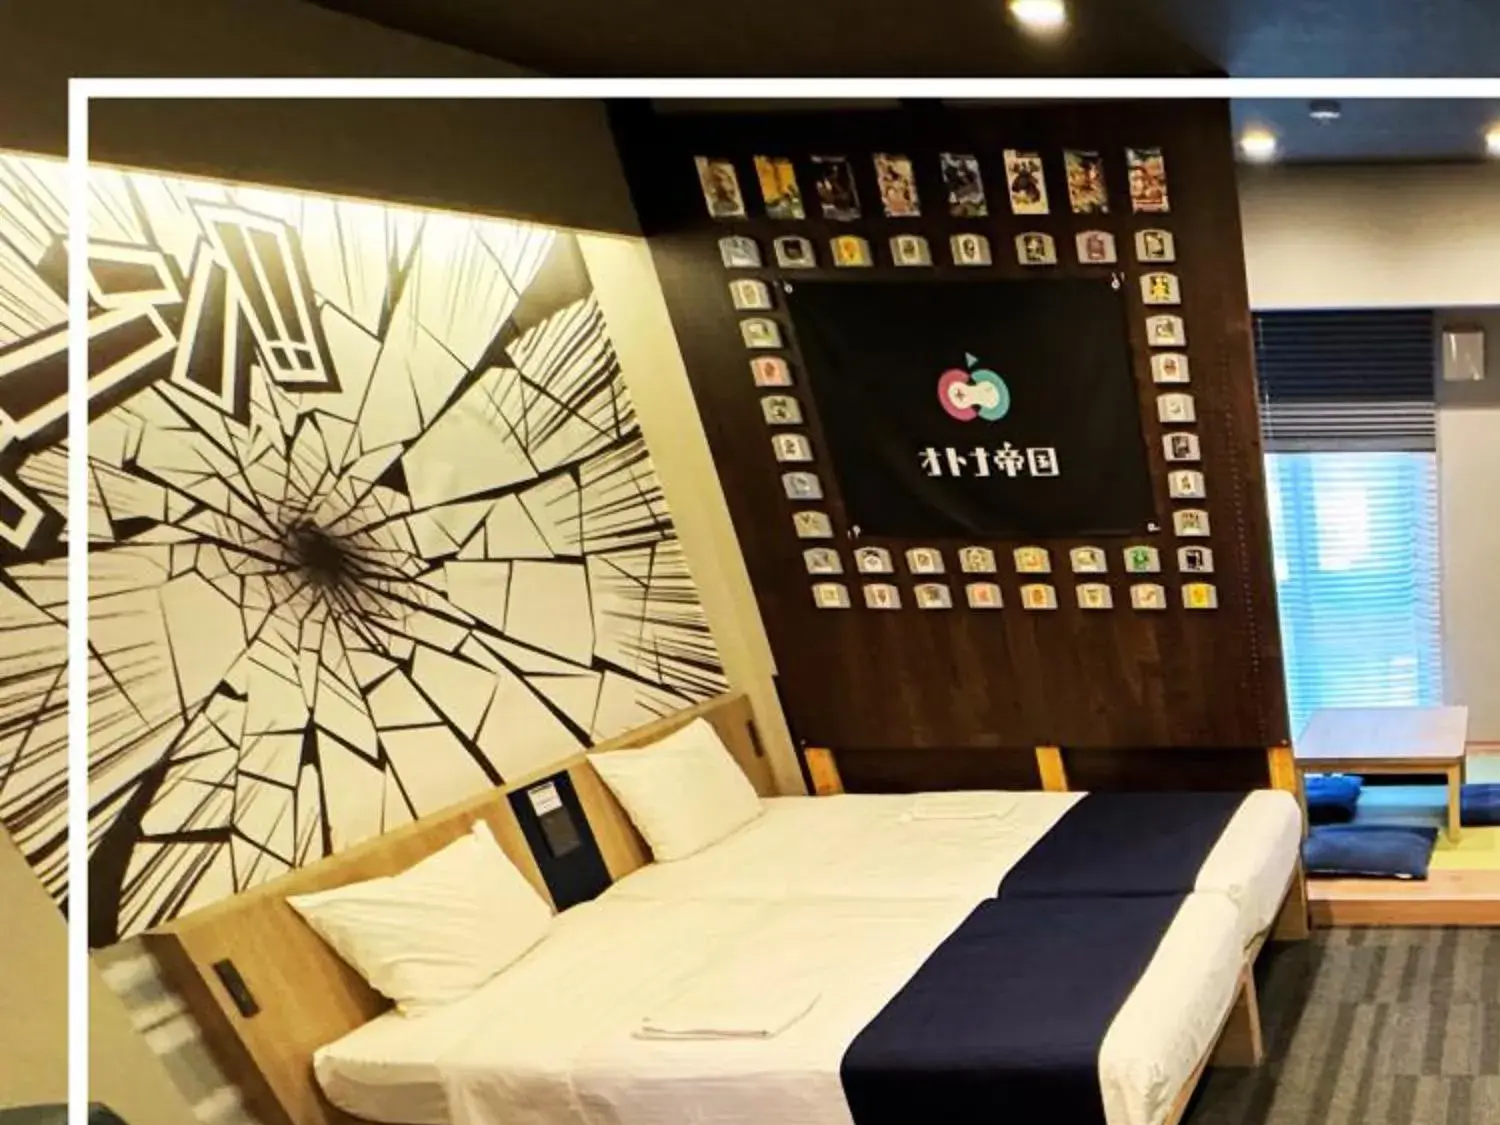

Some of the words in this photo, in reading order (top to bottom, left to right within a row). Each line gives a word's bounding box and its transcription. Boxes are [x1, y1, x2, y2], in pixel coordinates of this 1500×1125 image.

[917, 441, 1060, 477] オトナ帝国
